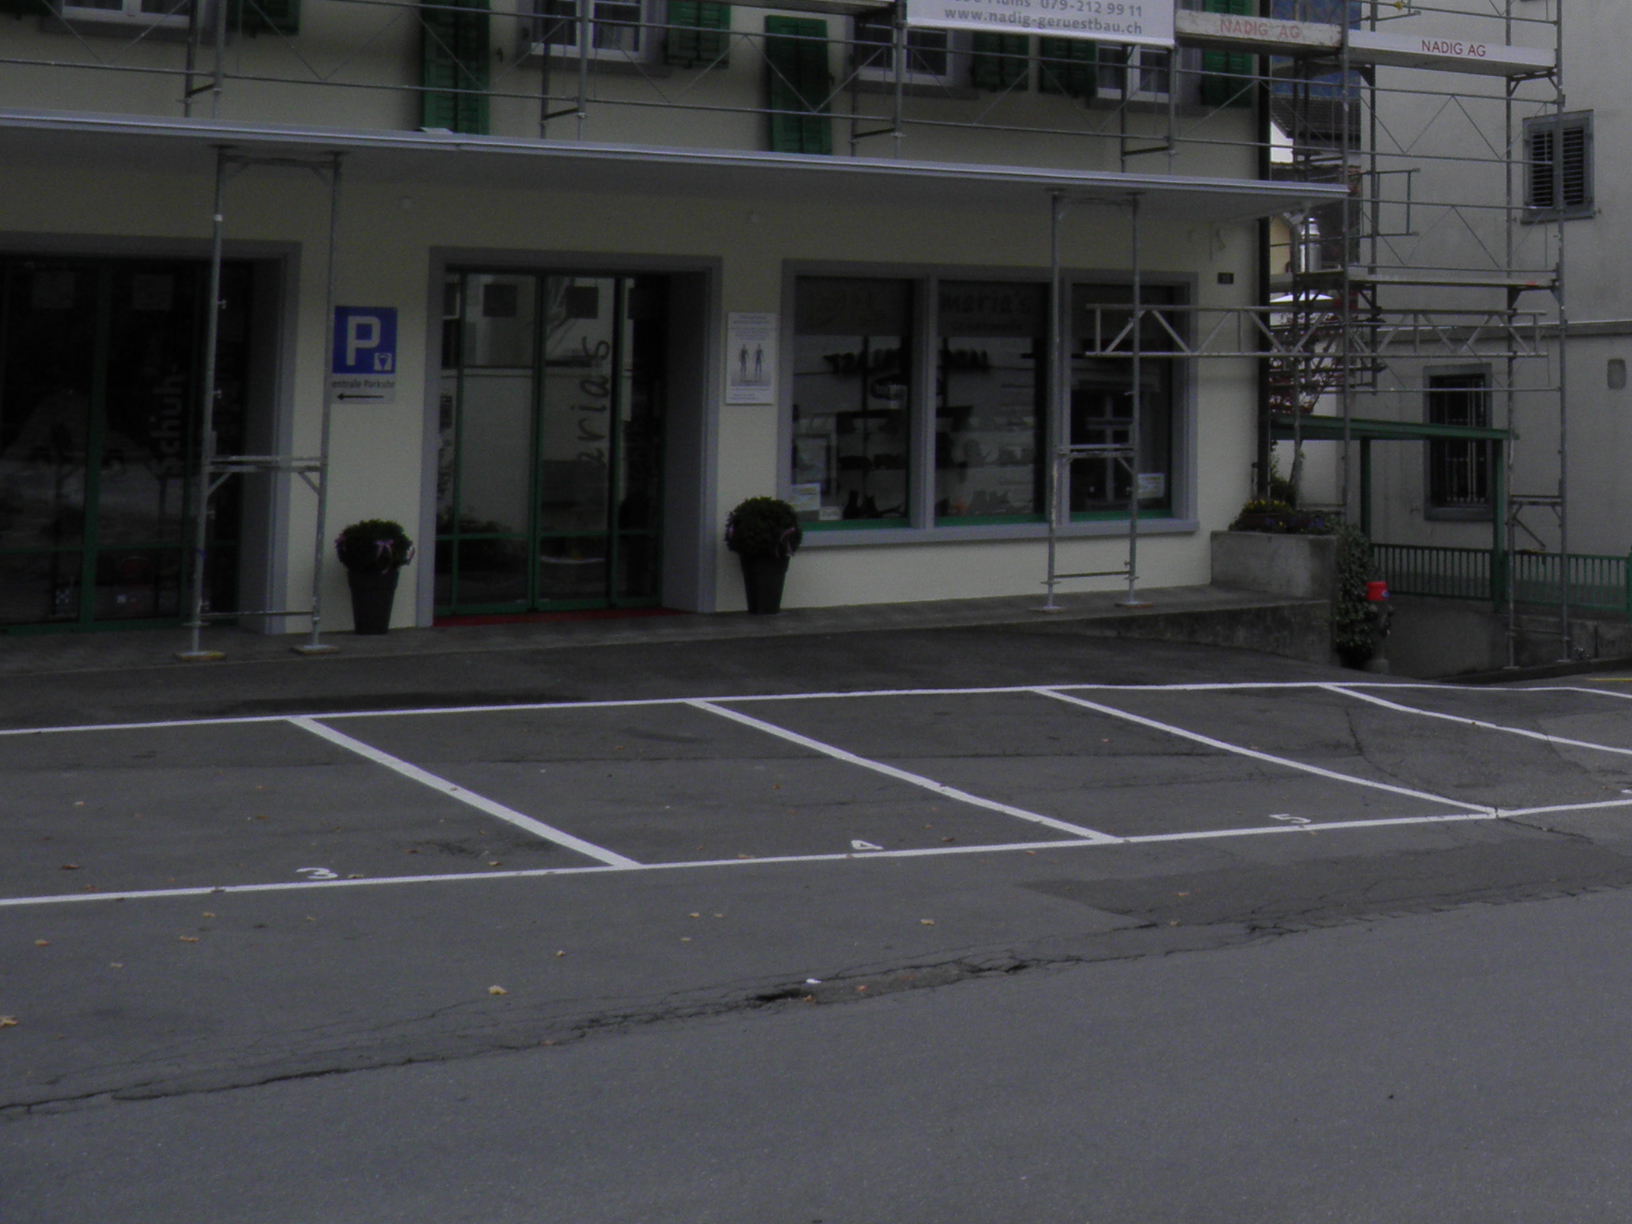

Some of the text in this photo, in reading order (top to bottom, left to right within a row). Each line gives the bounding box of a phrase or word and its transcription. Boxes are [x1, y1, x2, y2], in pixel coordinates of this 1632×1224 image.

[1106, 4, 1125, 17] 99
[1129, 6, 1143, 18] 11
[944, 7, 1143, 34] www.nadig-geruestbau.ch
[1219, 19, 1300, 40] NADIG AG
[1421, 40, 1486, 58] NADIG AG
[346, 315, 381, 366] P
[1269, 812, 1311, 824] 5
[296, 866, 338, 880] 3
